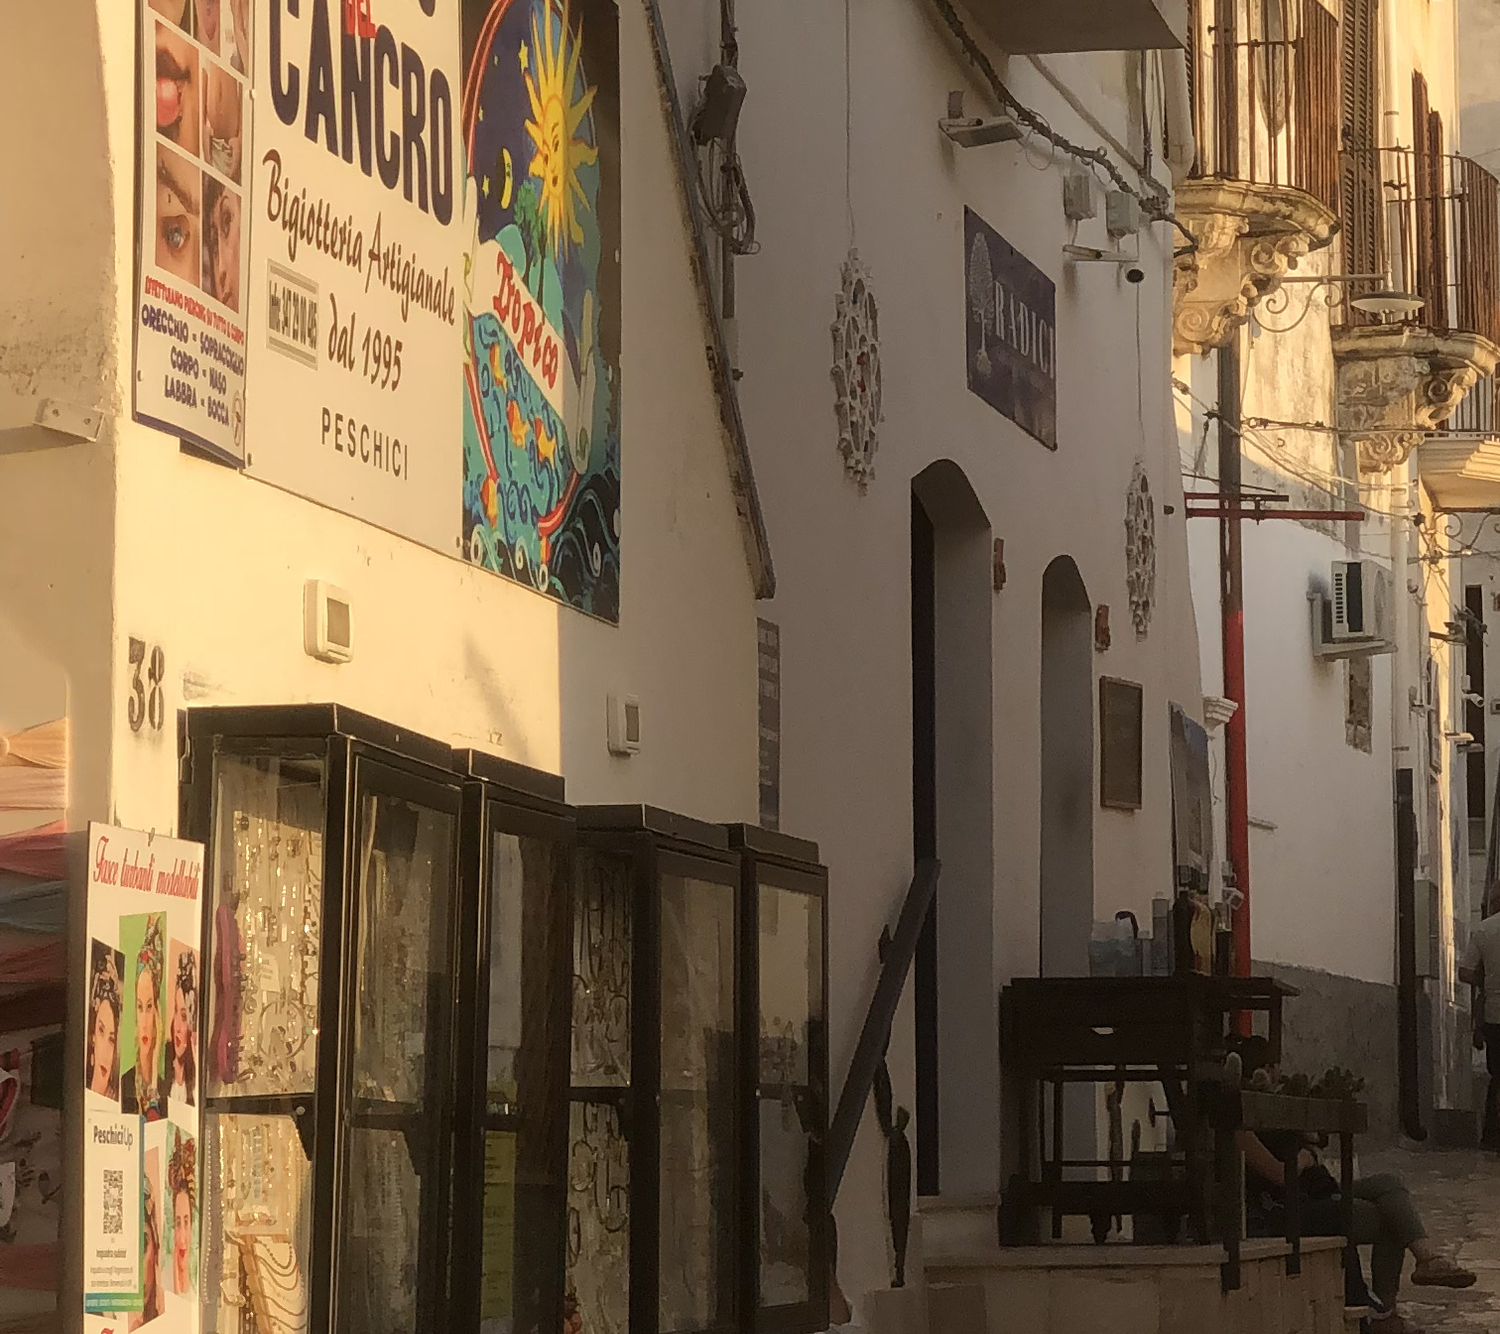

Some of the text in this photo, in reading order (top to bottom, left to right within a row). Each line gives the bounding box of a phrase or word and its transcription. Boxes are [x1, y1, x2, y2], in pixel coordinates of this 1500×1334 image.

[262, 149, 455, 326] Bigiotteria Artigianale
[141, 304, 189, 344] ORECCHIO
[328, 292, 403, 392] dal 1995
[493, 250, 559, 390] Tropico
[995, 280, 1054, 379] RADICI
[164, 374, 198, 409] LABBRA
[207, 396, 230, 427] BOCCA
[171, 345, 200, 380] CORPO
[209, 366, 227, 396] NASO
[322, 407, 408, 481] PESCHICI
[128, 636, 165, 733] 38
[93, 835, 119, 886] Fasce
[120, 848, 156, 892] turbanti
